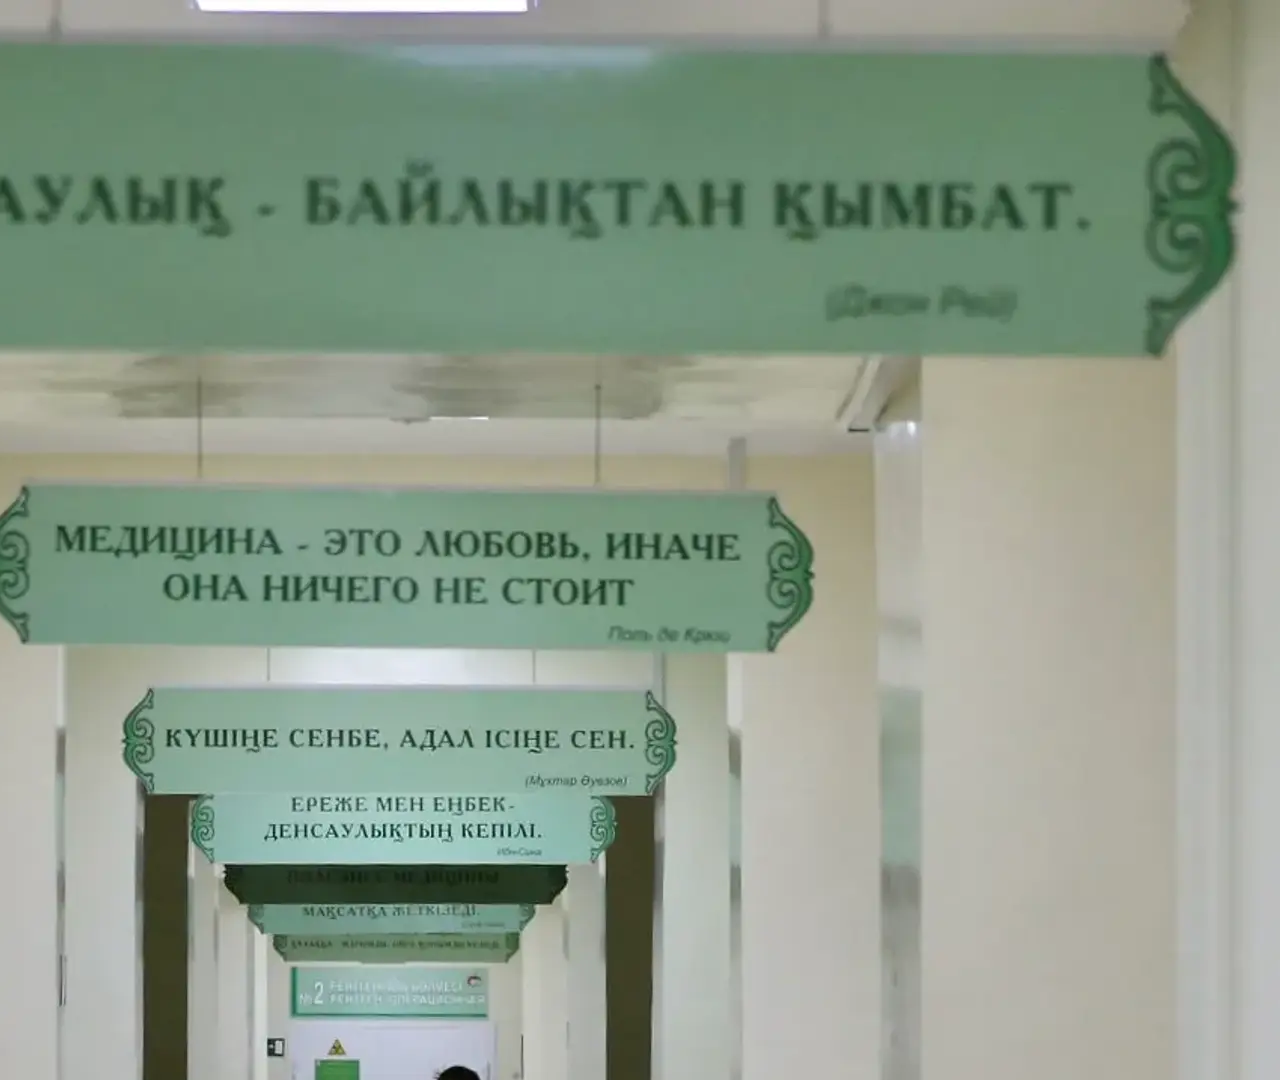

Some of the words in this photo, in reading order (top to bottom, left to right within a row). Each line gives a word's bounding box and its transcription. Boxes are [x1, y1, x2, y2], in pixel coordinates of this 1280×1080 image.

[306, 159, 744, 240] БАЙЛЫҚТАН
[775, 182, 1091, 241] ҚЫМБАТ.
[55, 524, 284, 560] МЕДИЦИНА
[323, 528, 402, 557] ЭТО
[414, 529, 591, 561] ЛЮБОВЬ,
[605, 532, 741, 562] ИНАЧЕ
[162, 573, 249, 602] ОНА
[262, 574, 420, 604] НИЧЕГО
[433, 576, 489, 605] НЕ
[501, 577, 635, 607] СТОИТ
[165, 728, 280, 754] КҮШІҢЕ
[288, 727, 389, 752] СЕНБЕ,
[399, 728, 475, 753] АДАЛ
[484, 729, 561, 755] ІСІҢЕ
[570, 729, 635, 750] СЕН.
[290, 796, 369, 813] ЕРЕЖЕ
[376, 796, 425, 813] МЕН
[263, 822, 454, 843] ДЕНСАУЛЫҚТЫҢ
[461, 822, 543, 840] КЕПІЛІ.
